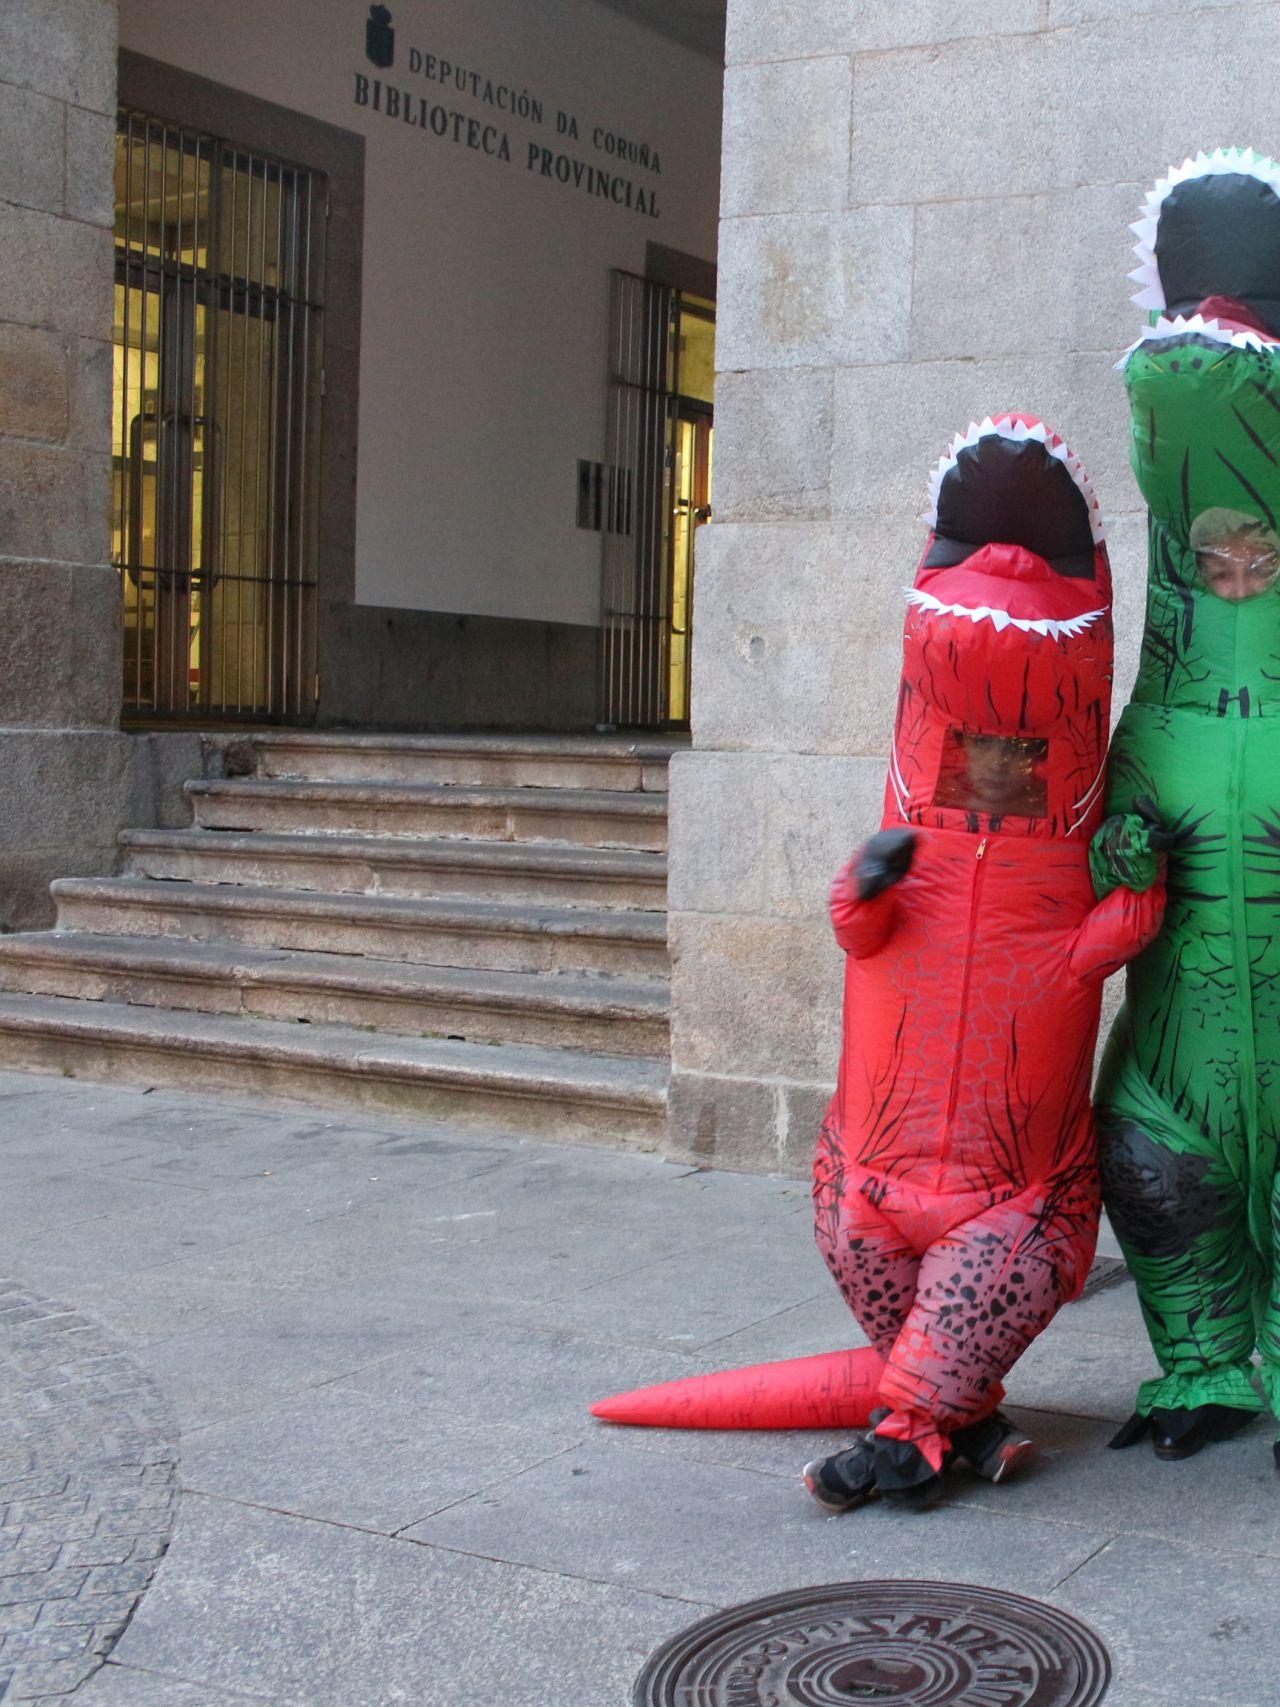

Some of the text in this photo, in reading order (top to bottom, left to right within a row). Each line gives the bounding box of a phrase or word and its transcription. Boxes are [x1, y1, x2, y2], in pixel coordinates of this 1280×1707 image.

[353, 73, 660, 219] BIBLIOTECA PROVINCIAL
[409, 47, 661, 174] DEPUTACIÓN DA CORUÑA
